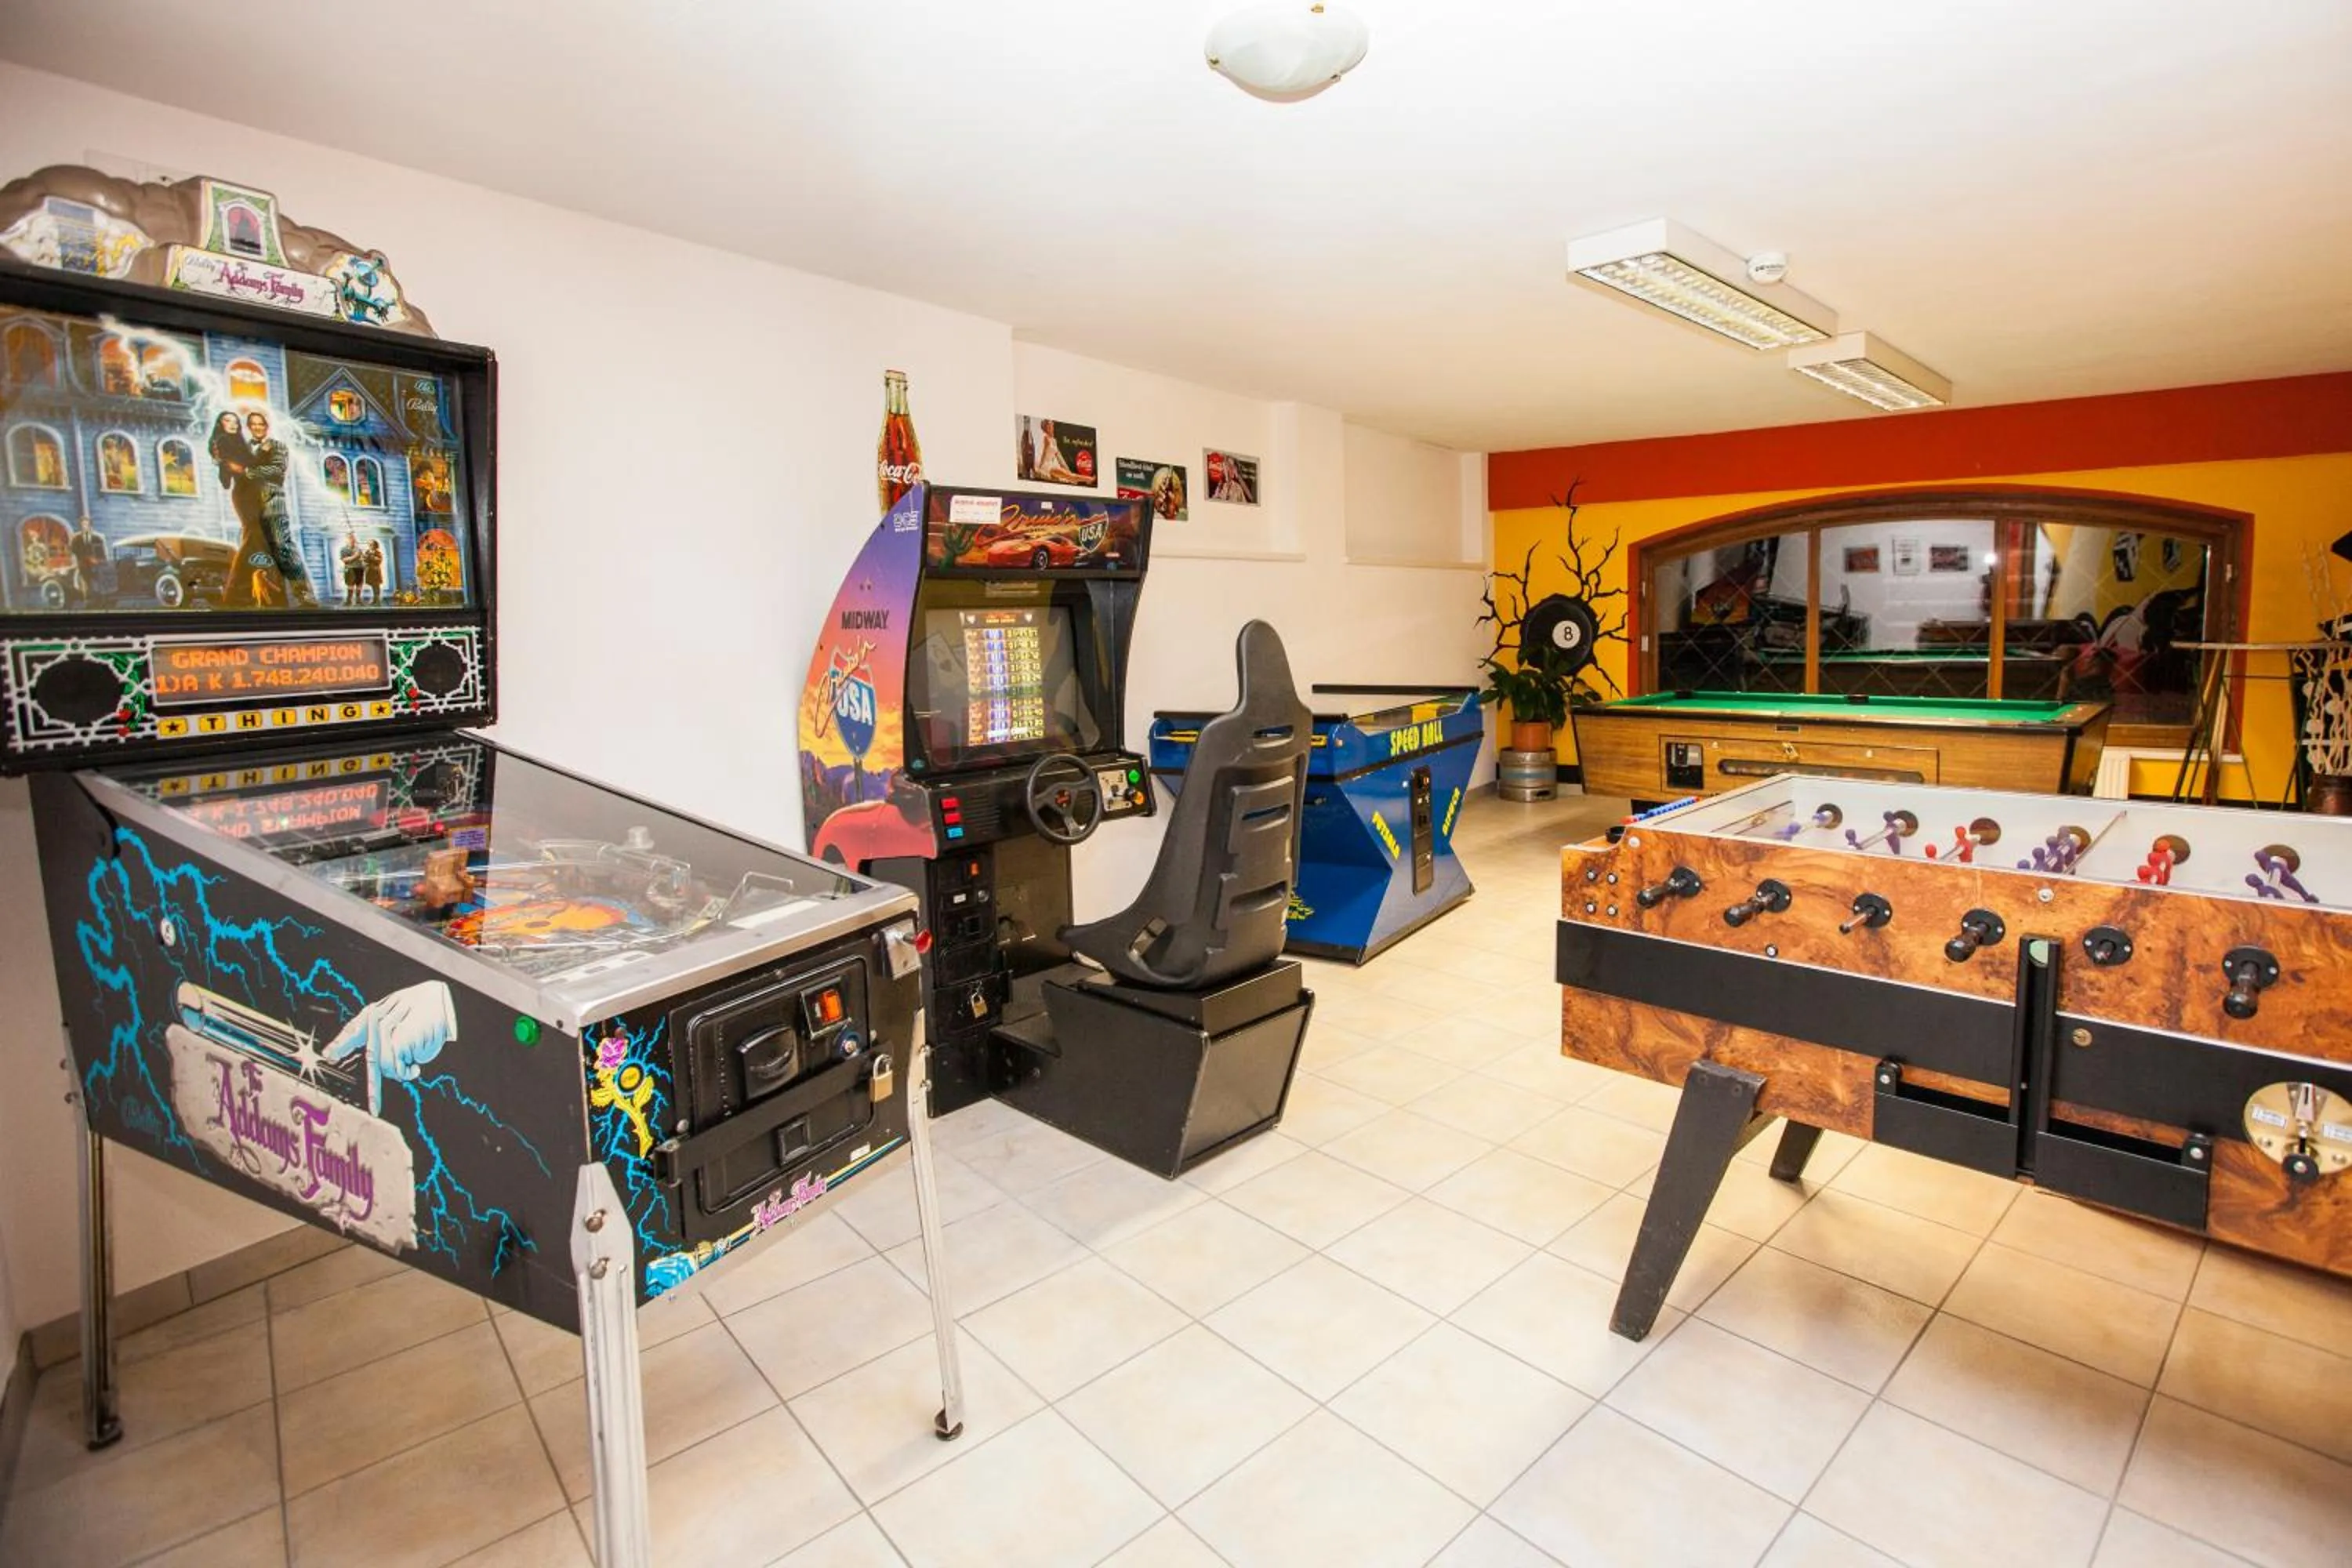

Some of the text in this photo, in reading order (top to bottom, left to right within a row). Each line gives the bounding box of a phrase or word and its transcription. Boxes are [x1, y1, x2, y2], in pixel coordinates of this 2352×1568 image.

[263, 271, 304, 303] Family
[1080, 521, 1102, 542] USA
[841, 611, 890, 630] MIDWAY
[1564, 626, 1573, 641] 8
[171, 643, 363, 669] GRAND CHAMPION
[232, 663, 379, 689] 1.748.240.040
[837, 682, 873, 726] USA
[206, 705, 357, 730] THING
[1390, 719, 1443, 757] SPEED BALL
[205, 1053, 375, 1221] Addams Family
